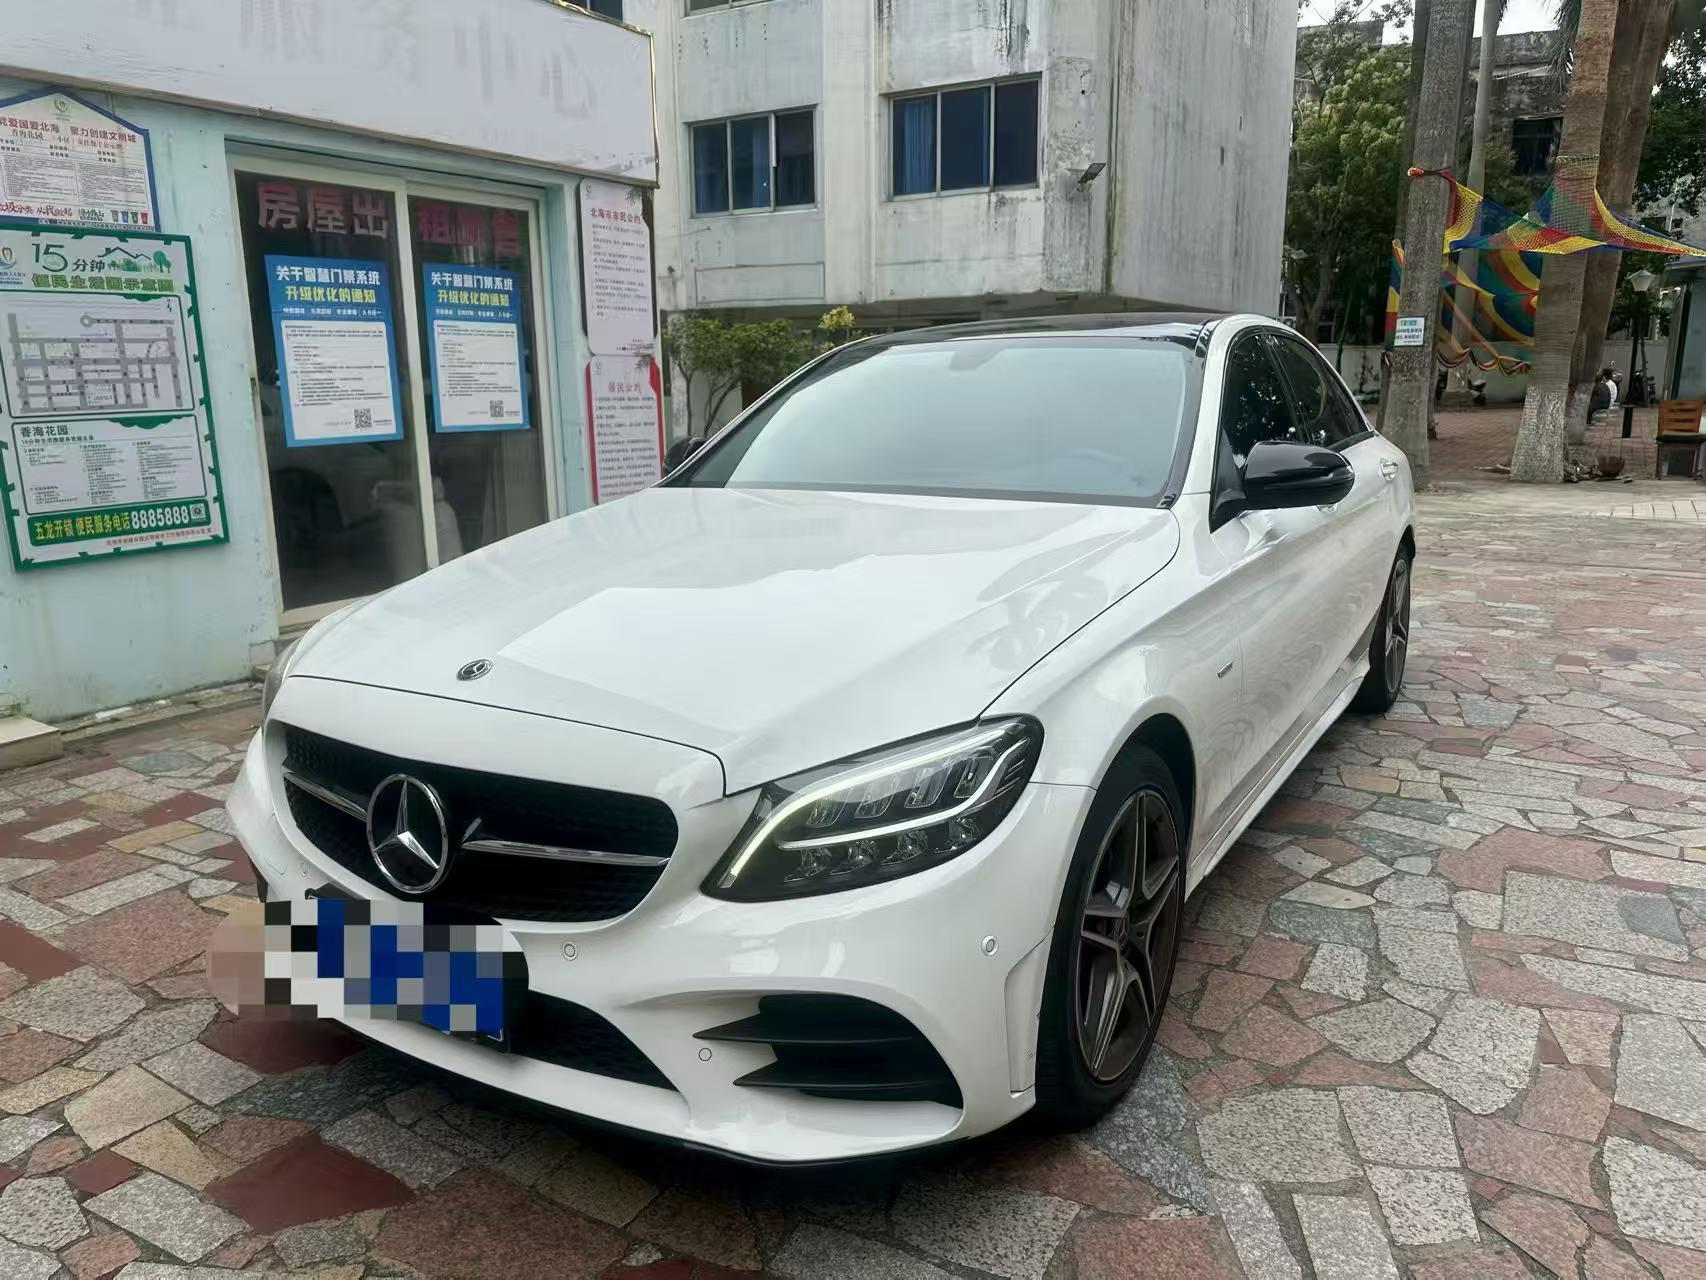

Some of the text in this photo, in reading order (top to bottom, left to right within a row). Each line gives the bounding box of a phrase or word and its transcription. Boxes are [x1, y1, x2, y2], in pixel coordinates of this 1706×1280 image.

[257, 182, 389, 239] 房屋出
[276, 265, 381, 286] 关于智慧门禁系统
[431, 271, 513, 292] 关于智慧门禁系统
[285, 286, 377, 304] 升级优化的通知
[437, 289, 510, 307] 升级优化的通知
[20, 424, 69, 438] 香海花园
[35, 515, 75, 540] 五龙开锁
